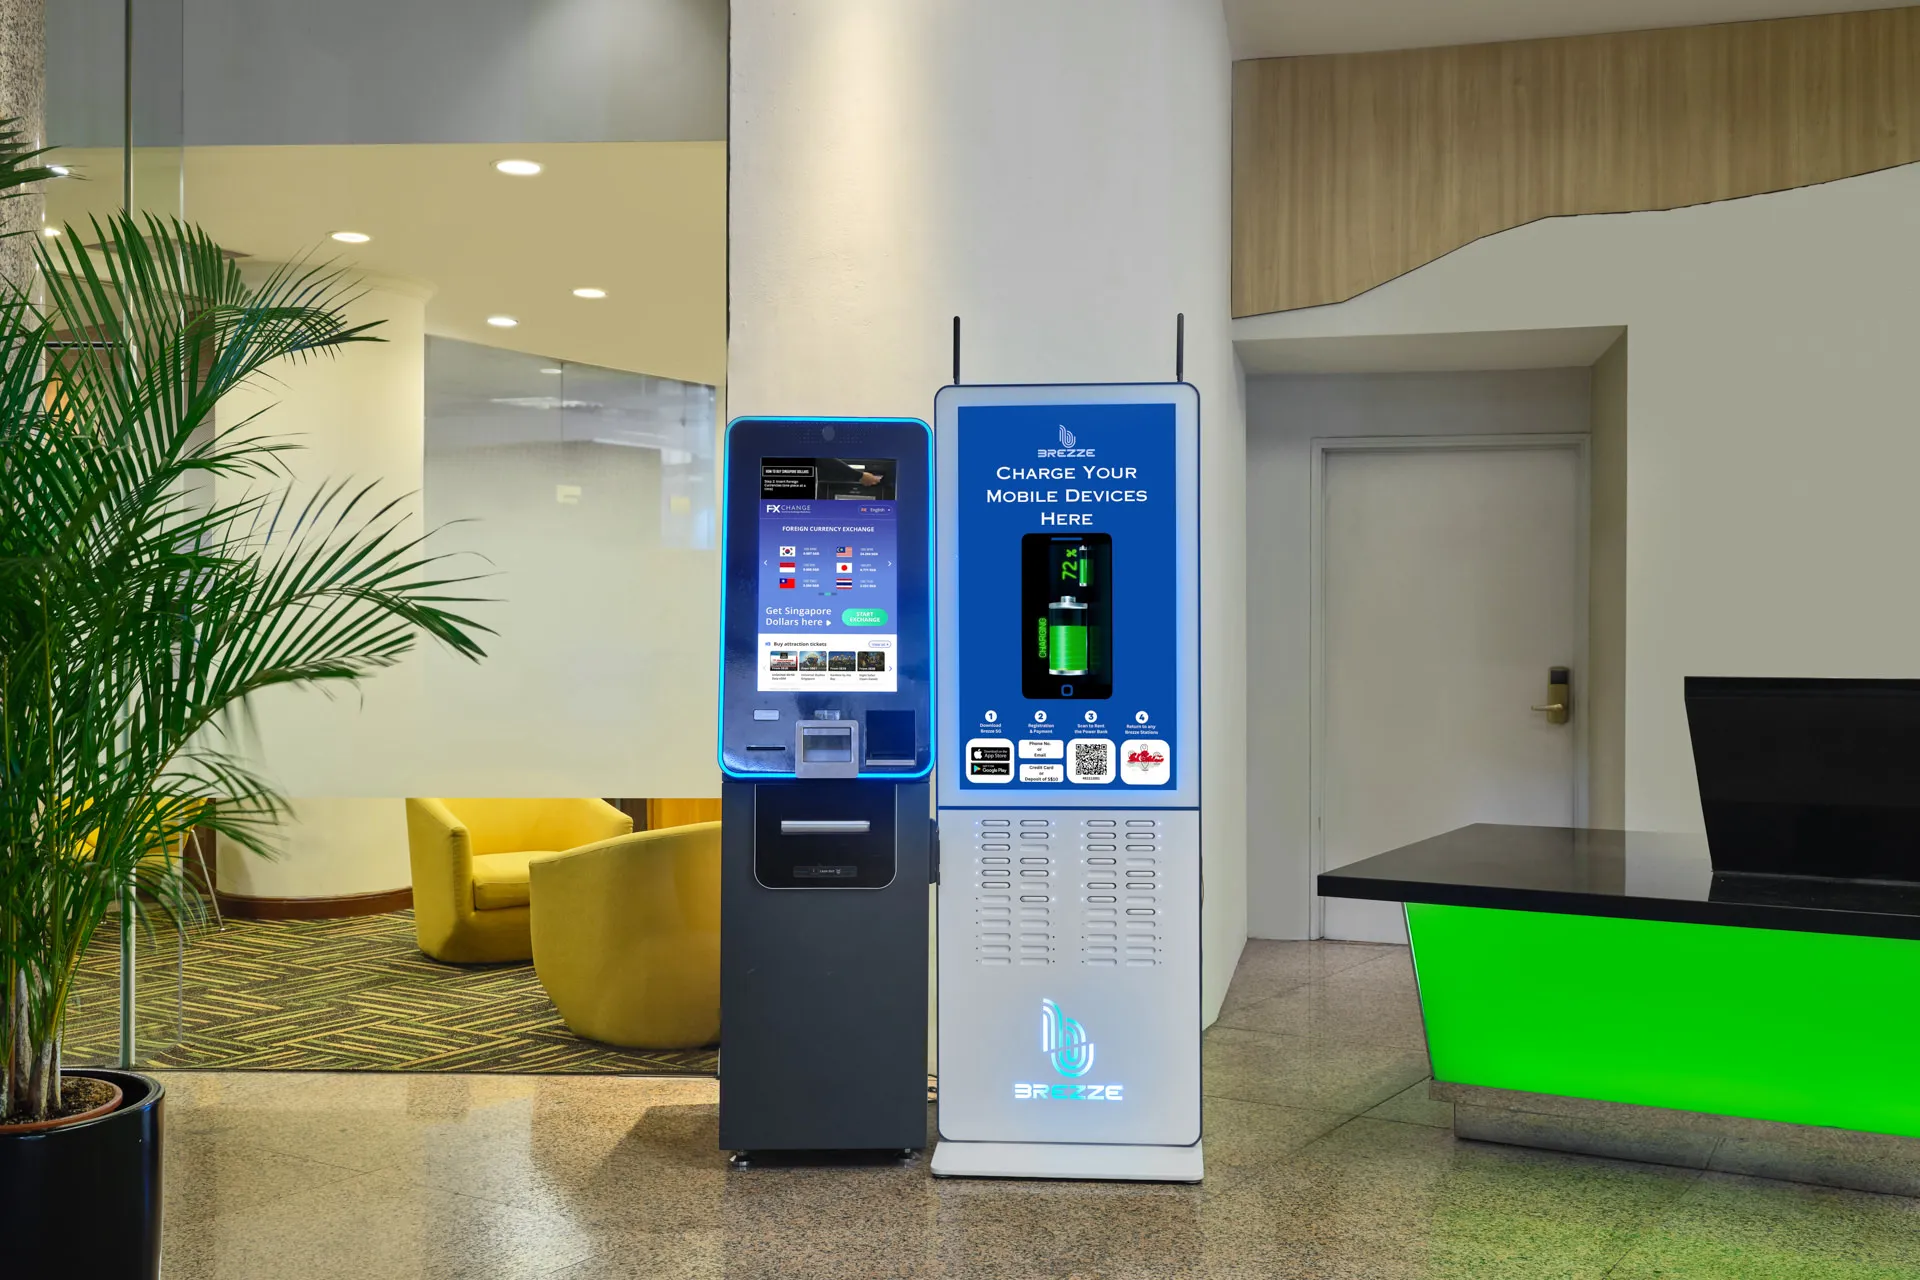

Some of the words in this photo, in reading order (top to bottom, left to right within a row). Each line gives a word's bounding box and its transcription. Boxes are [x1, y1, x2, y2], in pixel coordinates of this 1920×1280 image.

[1037, 449, 1095, 458] BREZZE
[996, 466, 1076, 480] CHARGE
[1083, 465, 1137, 479] YOUR
[986, 489, 1058, 503] MOBILE
[1065, 489, 1148, 503] DEVICES
[1041, 512, 1093, 525] HERE
[1061, 561, 1078, 580] 72
[765, 606, 783, 615] Get
[785, 606, 832, 617] Singapore
[765, 617, 799, 626] Dollars
[801, 617, 823, 626] here
[1038, 617, 1047, 658] CHARGING
[1014, 1083, 1123, 1101] BREZZE
